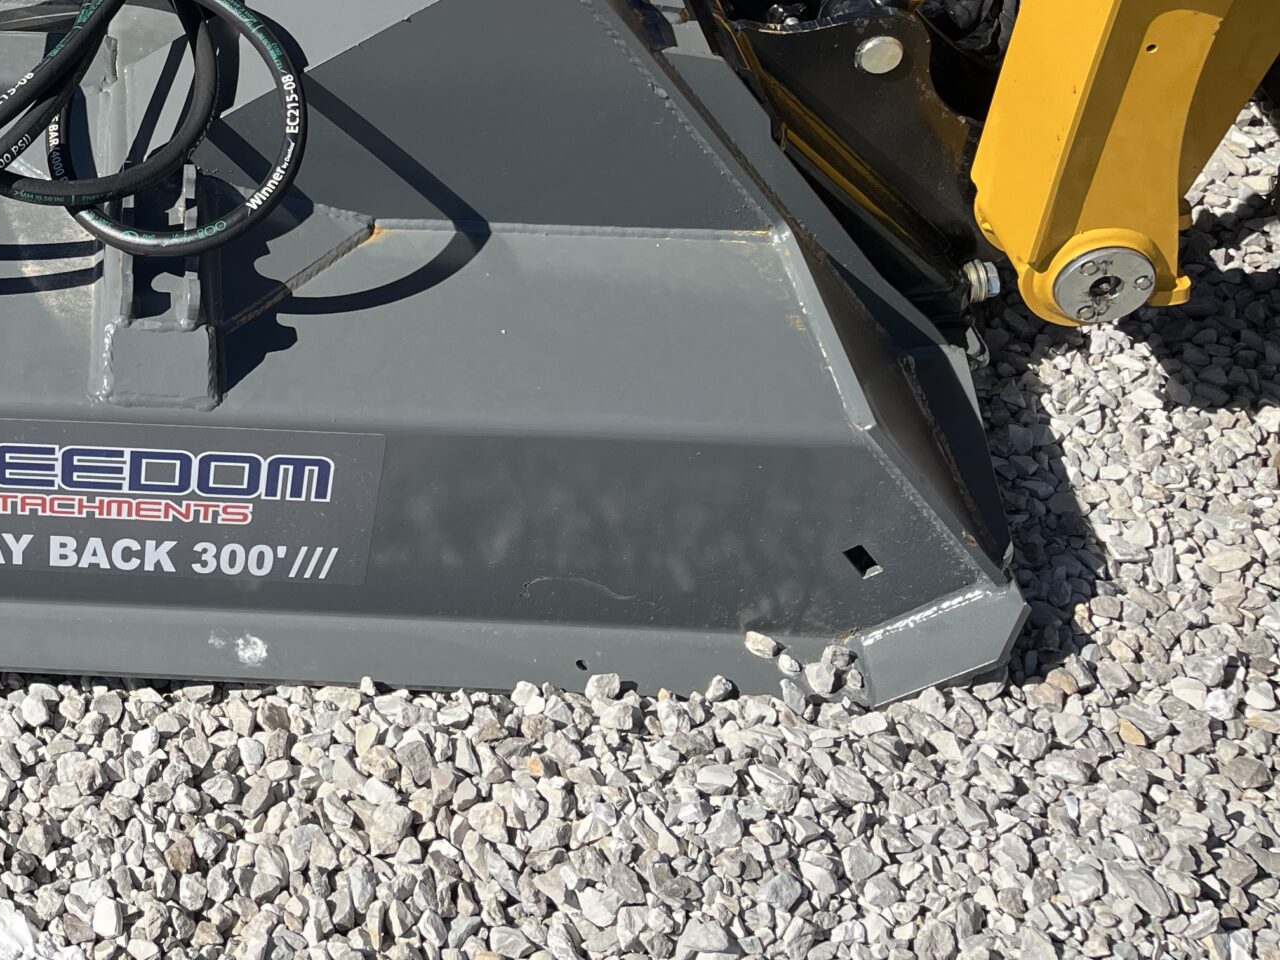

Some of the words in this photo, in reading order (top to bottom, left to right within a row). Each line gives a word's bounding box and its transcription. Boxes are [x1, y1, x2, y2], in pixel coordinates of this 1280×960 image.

[11, 133, 32, 160] PSI)
[246, 166, 286, 210] Winner
[281, 74, 300, 135] EC215-08
[49, 534, 178, 573] BACK
